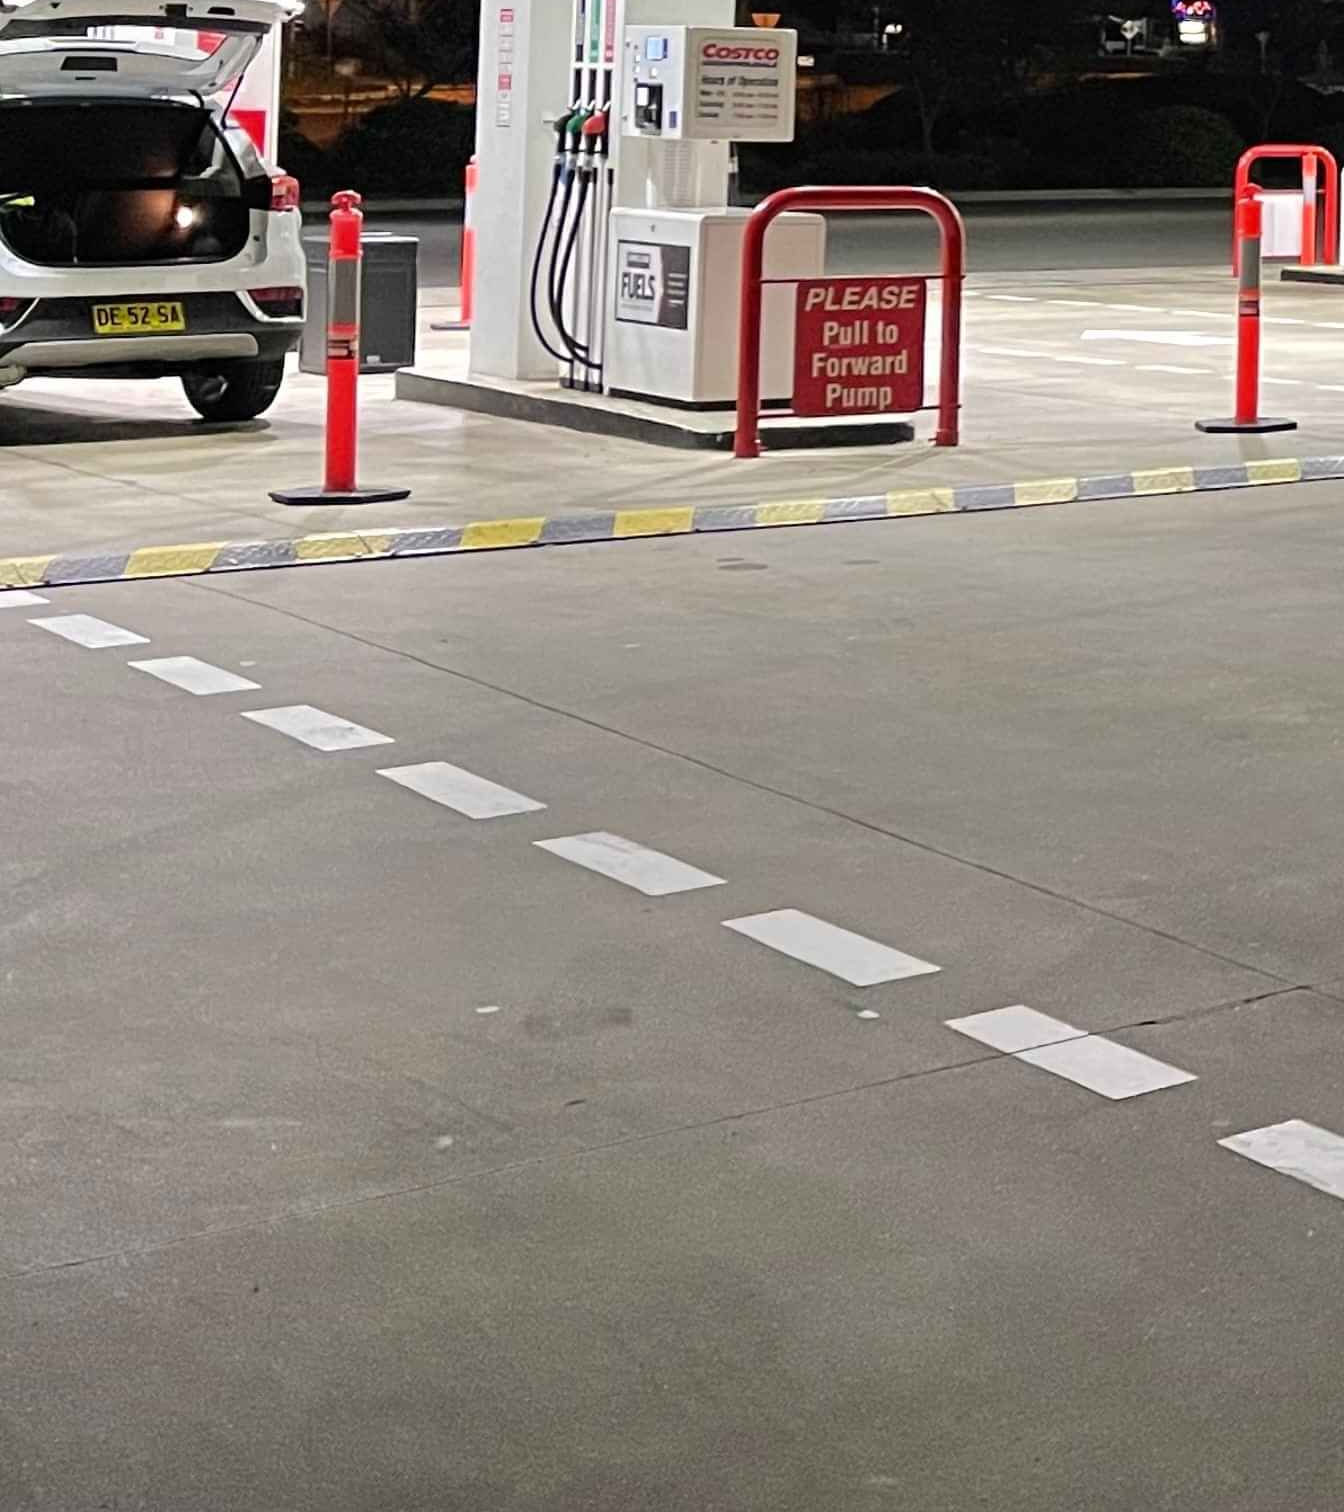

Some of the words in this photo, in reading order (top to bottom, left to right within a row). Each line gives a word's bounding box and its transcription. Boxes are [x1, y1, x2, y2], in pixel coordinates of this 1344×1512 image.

[703, 43, 779, 61] COSTCO
[622, 272, 655, 300] FUELS
[805, 286, 919, 312] PLEASE
[97, 307, 122, 326] DE
[127, 305, 150, 325] 52
[157, 304, 181, 324] SA
[823, 320, 869, 346] Pull
[876, 321, 899, 344] to
[811, 349, 908, 378] Forward
[826, 383, 892, 410] Pump
